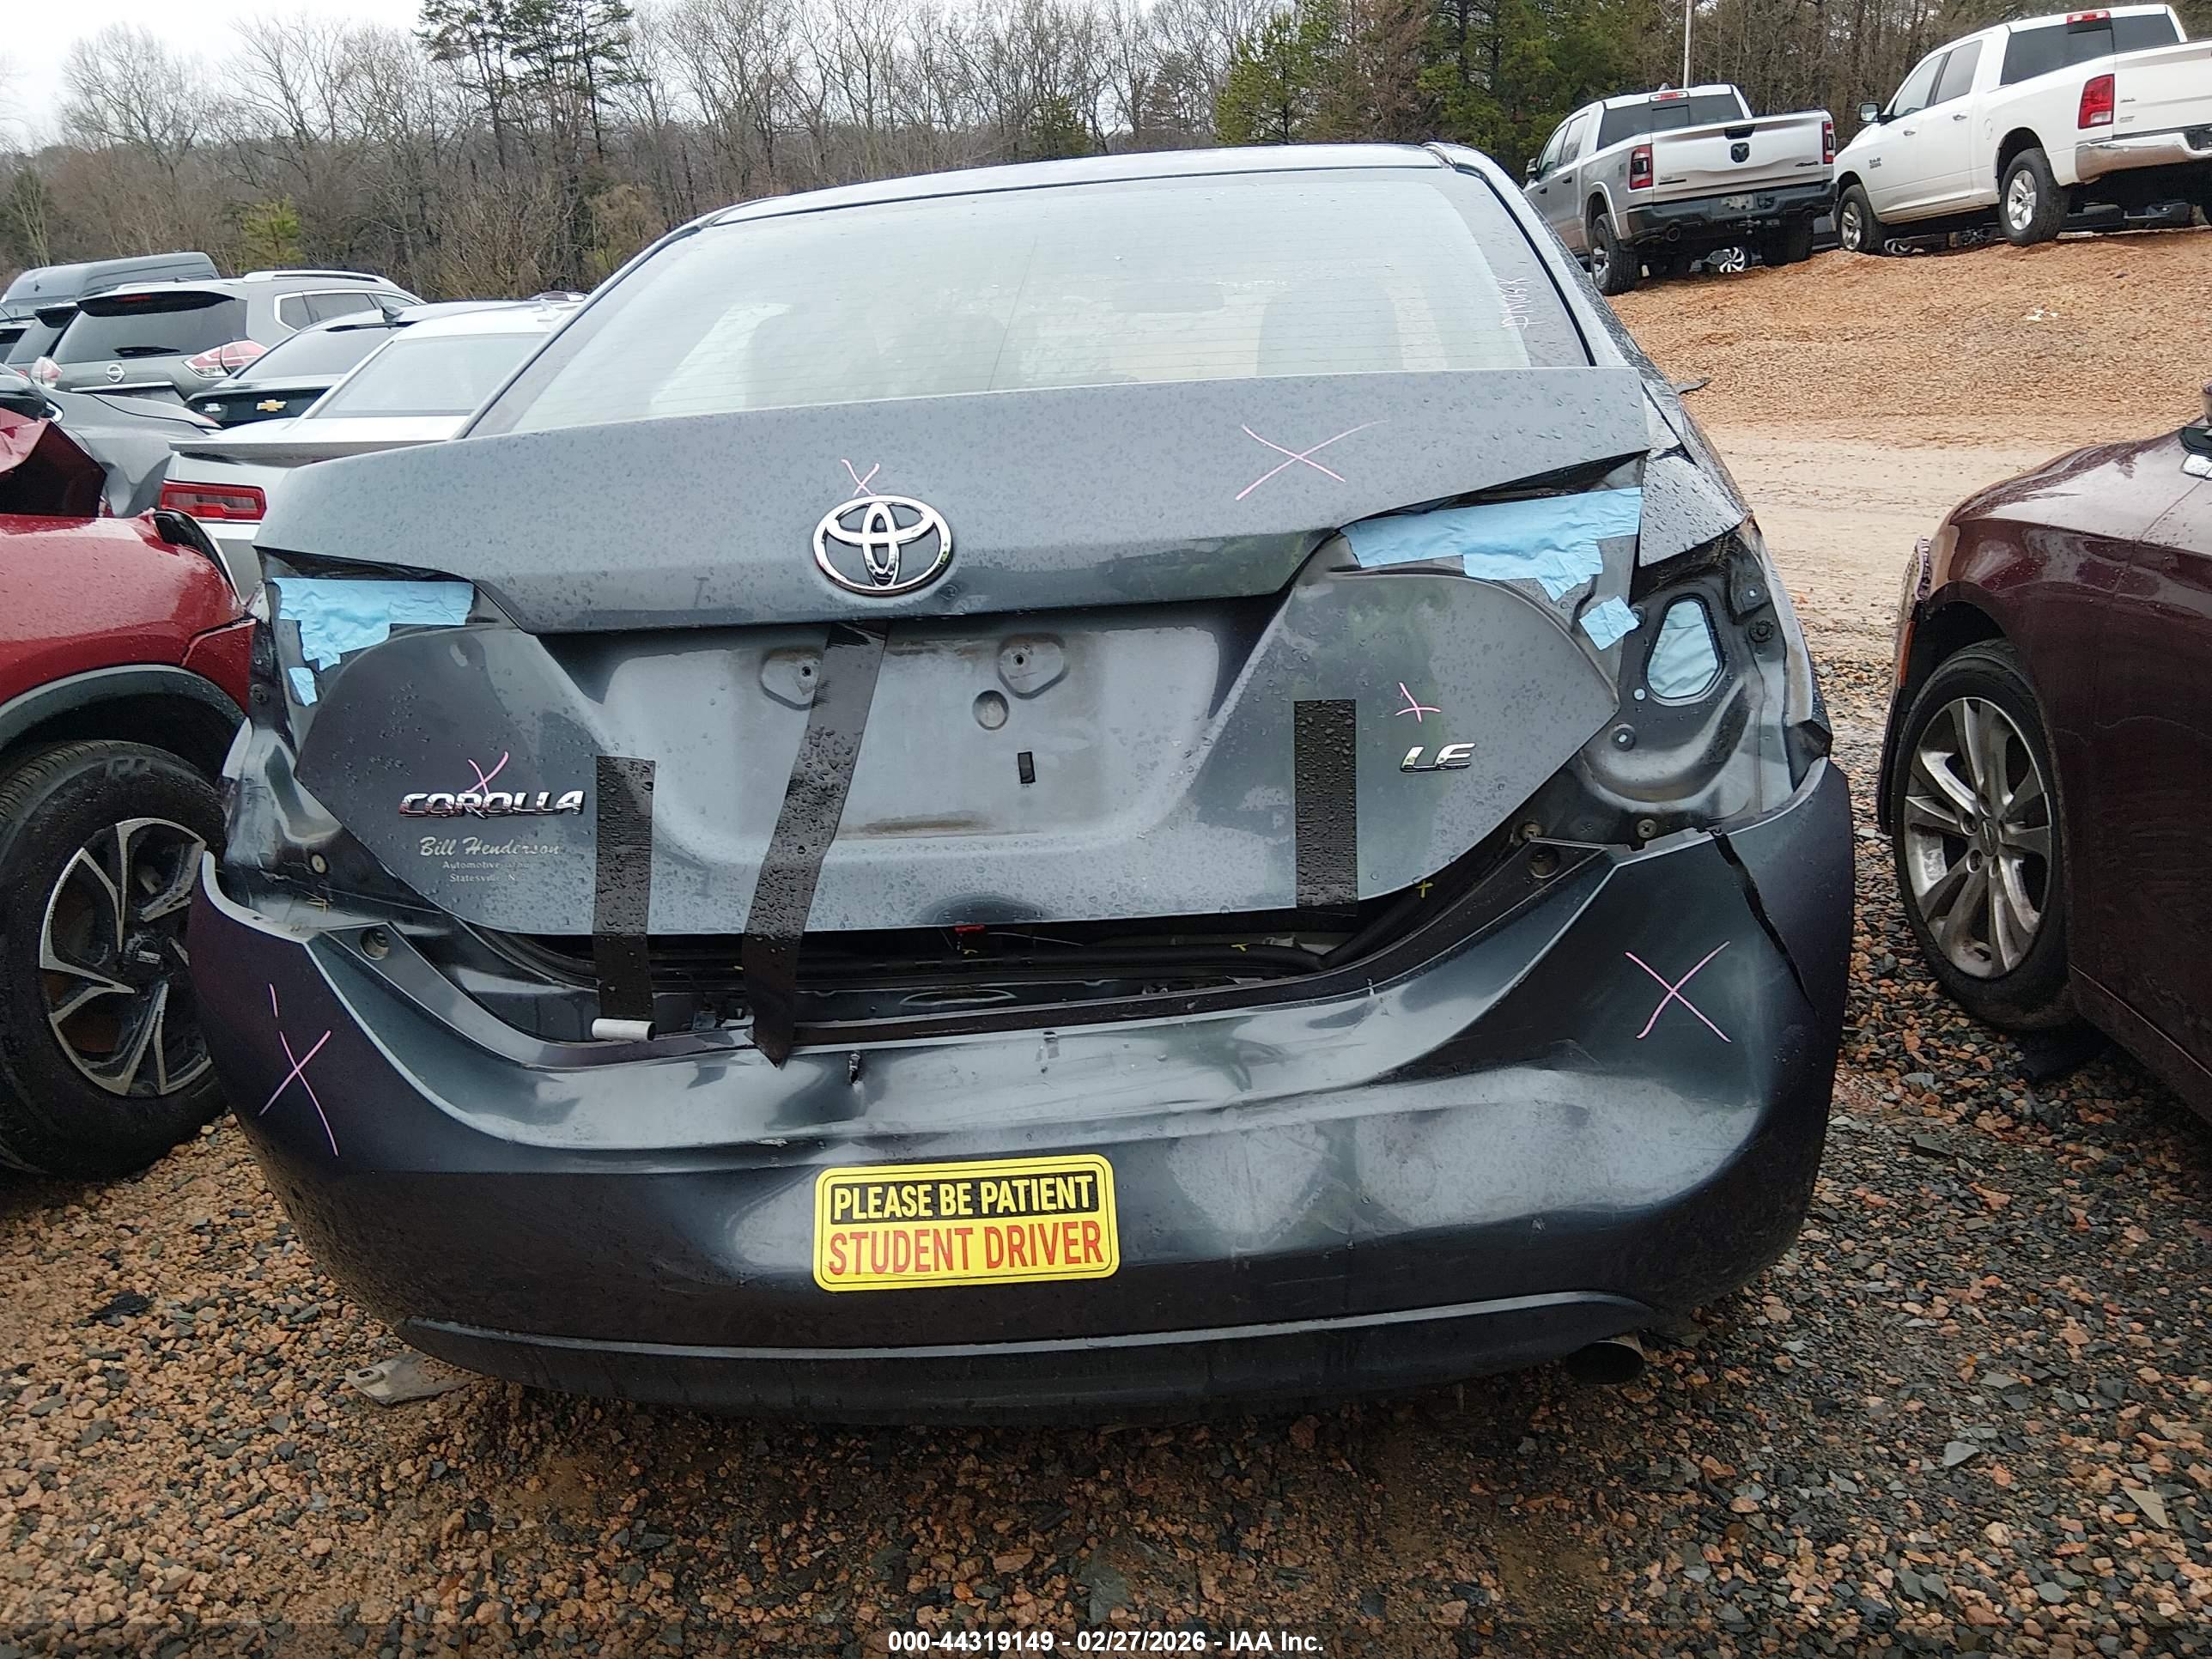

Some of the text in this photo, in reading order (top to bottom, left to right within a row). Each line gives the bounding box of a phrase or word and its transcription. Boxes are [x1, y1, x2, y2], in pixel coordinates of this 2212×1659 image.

[1401, 743, 1475, 772] LE
[398, 790, 585, 818] COROLLA
[420, 836, 560, 857] Bill Henderson
[441, 860, 501, 871] Automotive
[833, 1175, 1094, 1220] PLEASE BE PATIENT
[829, 1220, 1104, 1276] STUDENT DRIVER
